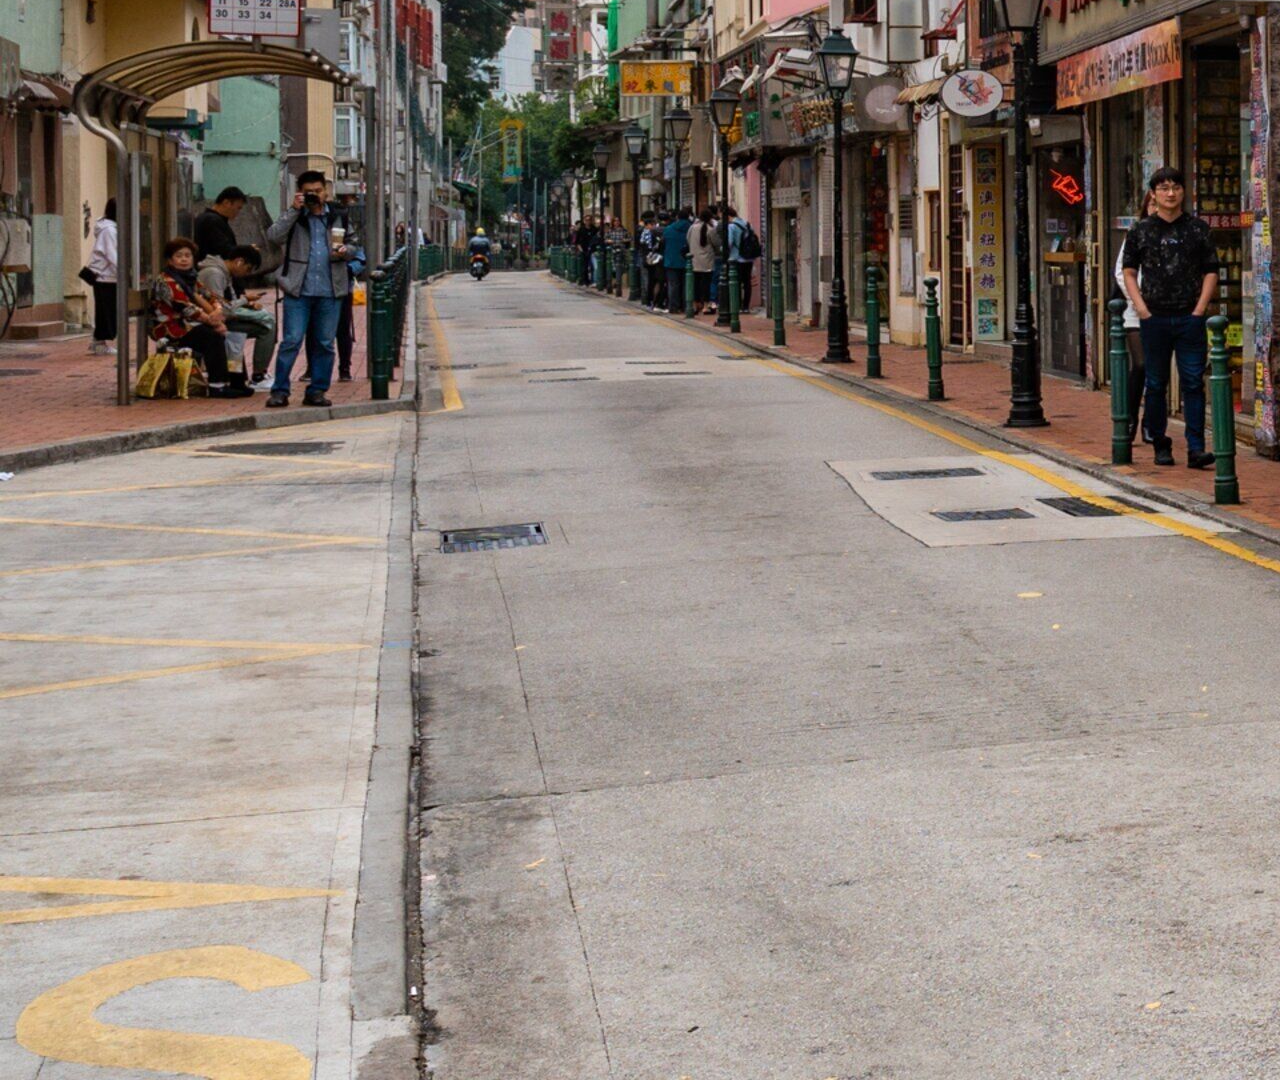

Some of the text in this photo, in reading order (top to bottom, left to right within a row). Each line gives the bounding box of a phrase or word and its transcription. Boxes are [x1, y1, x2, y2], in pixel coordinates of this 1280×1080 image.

[279, 0, 296, 8] 28A
[215, 9, 272, 20] 30 33 34
